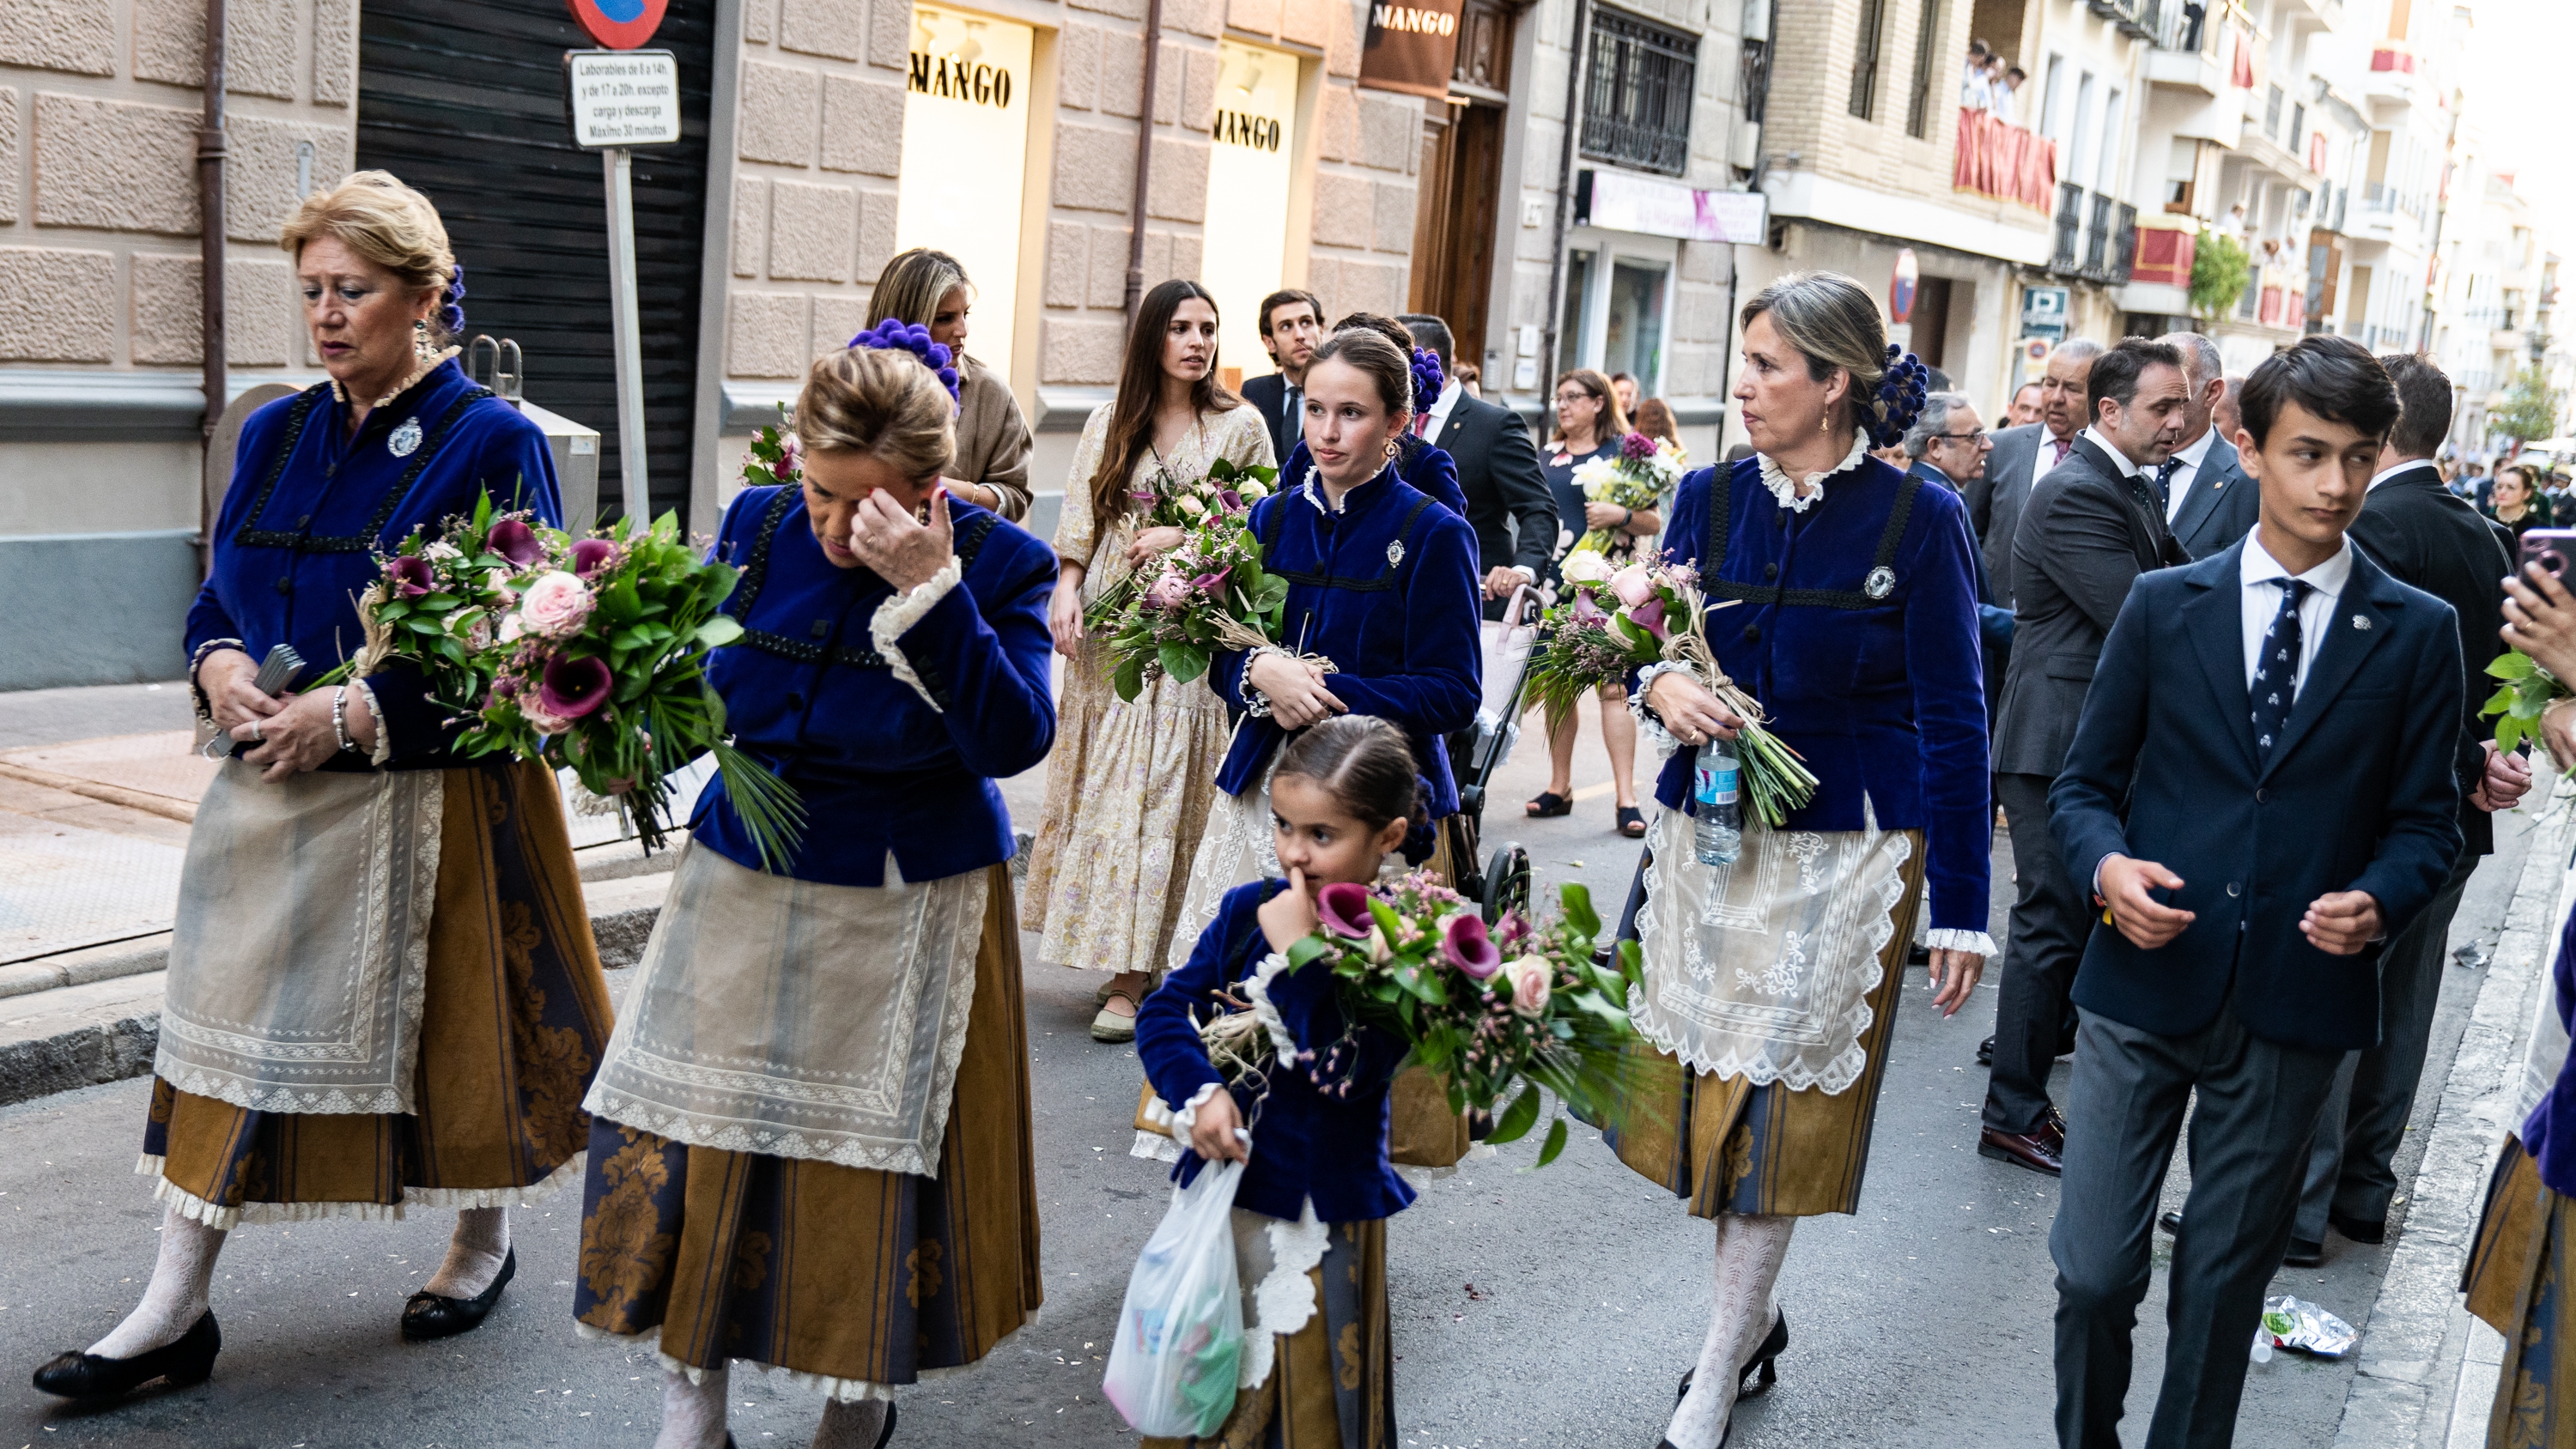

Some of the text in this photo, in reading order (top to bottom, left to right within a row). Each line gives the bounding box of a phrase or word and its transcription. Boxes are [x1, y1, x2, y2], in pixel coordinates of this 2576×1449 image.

[1373, 3, 1455, 37] MANGO
[580, 63, 627, 76] Laborables
[628, 63, 638, 76] de
[646, 66, 652, 76] a
[652, 63, 669, 76] 14h.
[908, 52, 1011, 108] MANGO
[581, 87, 587, 100] y
[589, 84, 599, 96] de
[601, 83, 611, 96] 17
[612, 87, 617, 96] a
[637, 85, 669, 98] excepto
[592, 105, 662, 120] carga y descarga
[623, 124, 633, 136] 30
[635, 124, 667, 136] minutos
[2032, 292, 2057, 314] P
